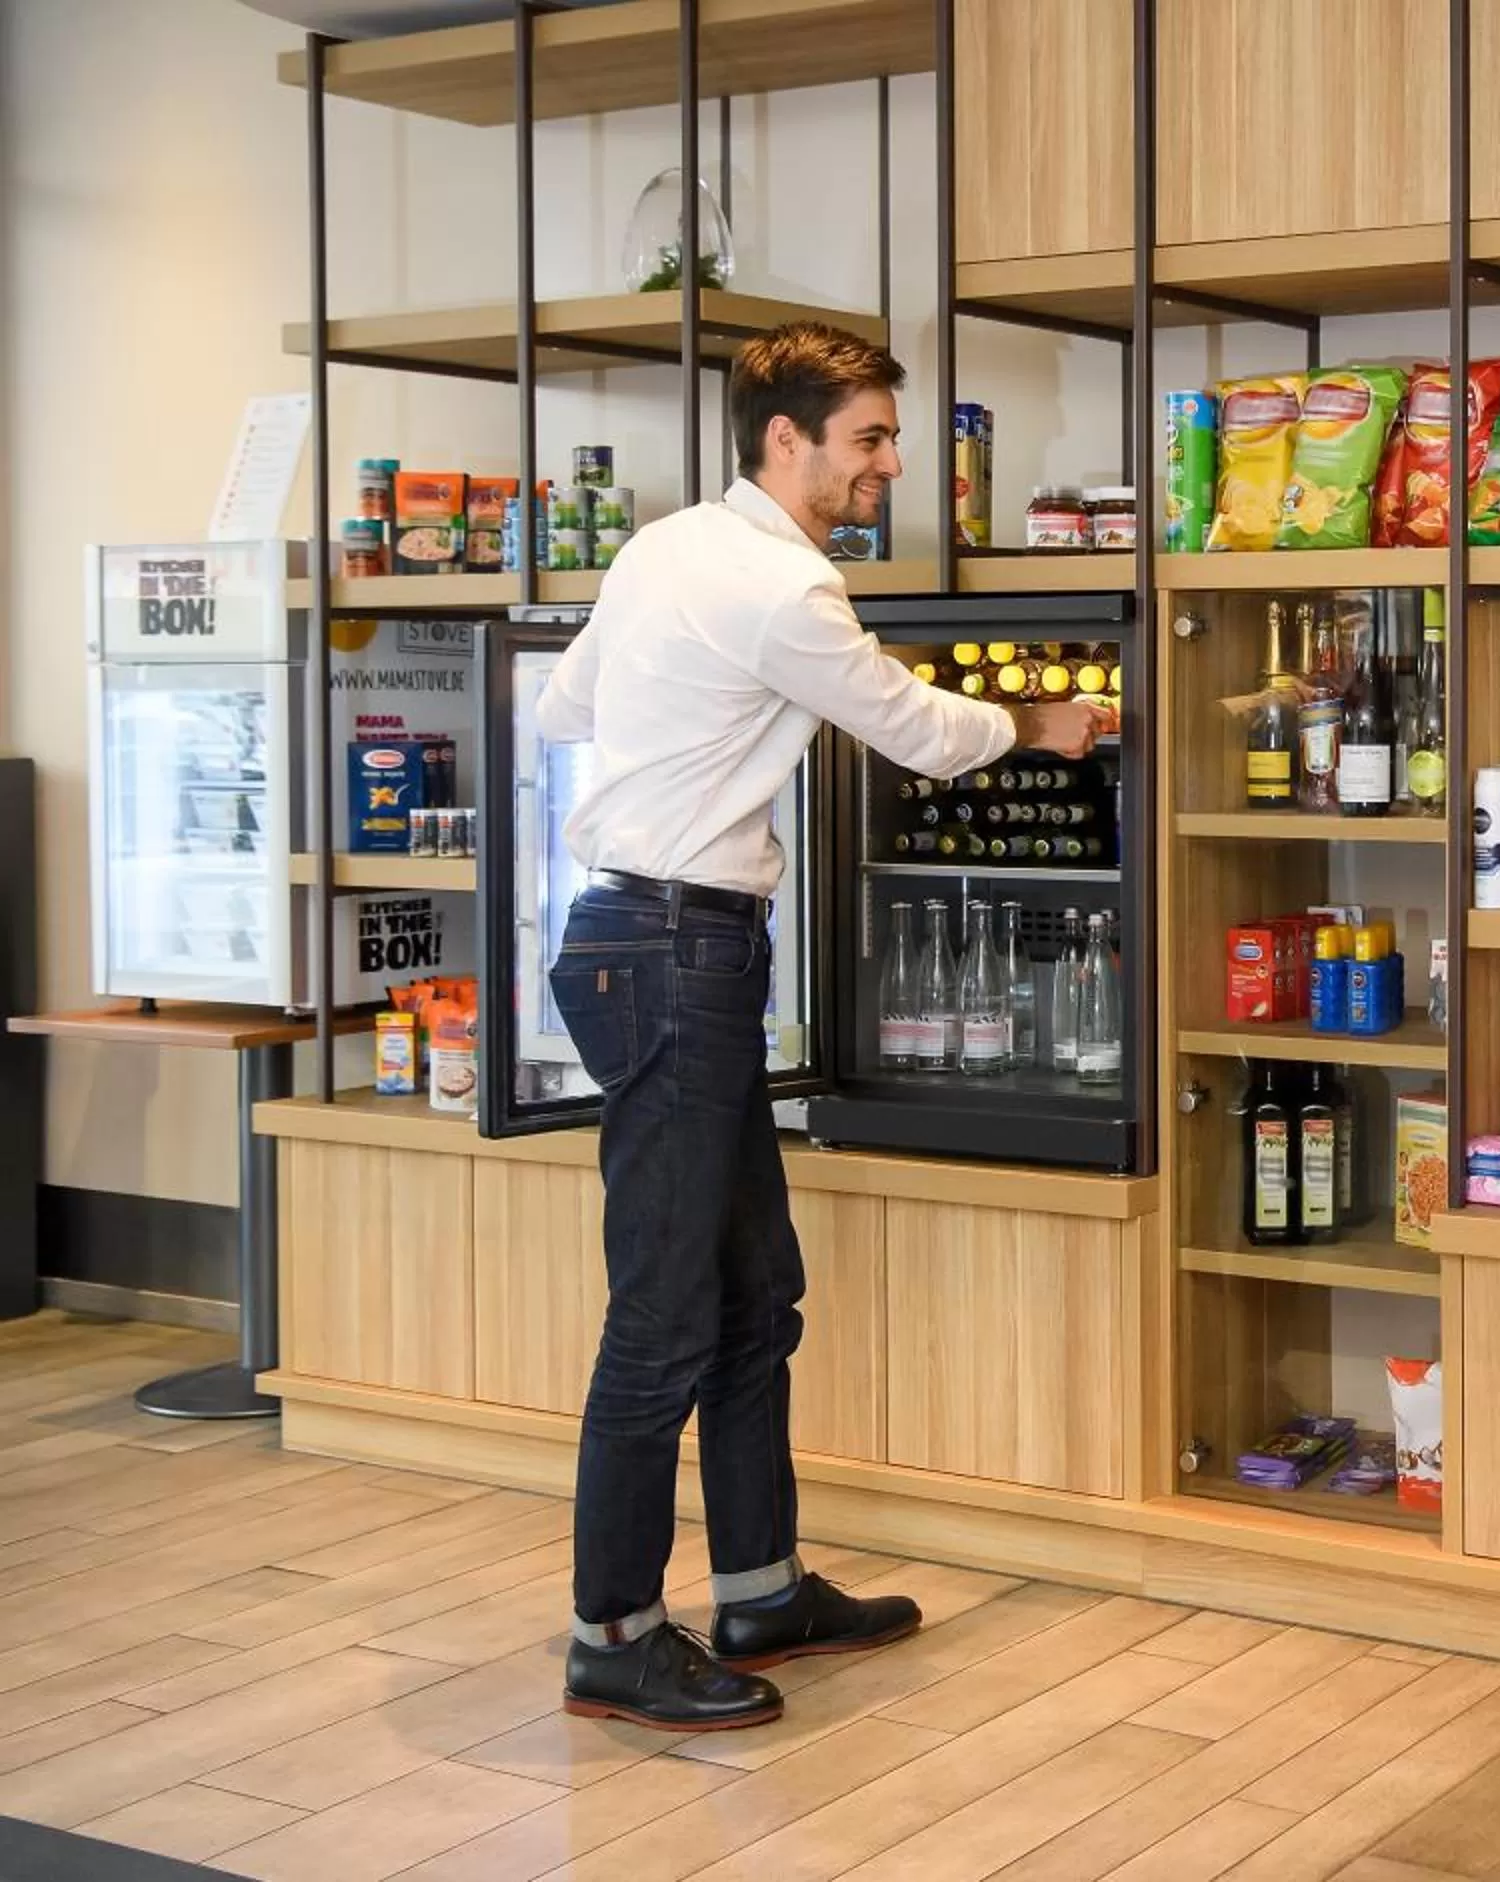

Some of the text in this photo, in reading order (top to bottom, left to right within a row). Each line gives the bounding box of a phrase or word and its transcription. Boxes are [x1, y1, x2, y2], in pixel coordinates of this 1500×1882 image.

[409, 622, 469, 643] STOVE
[356, 714, 404, 728] MAMA
[359, 897, 432, 914] KITCHEN
[359, 911, 433, 936] IN THE
[359, 931, 442, 973] BOX!
